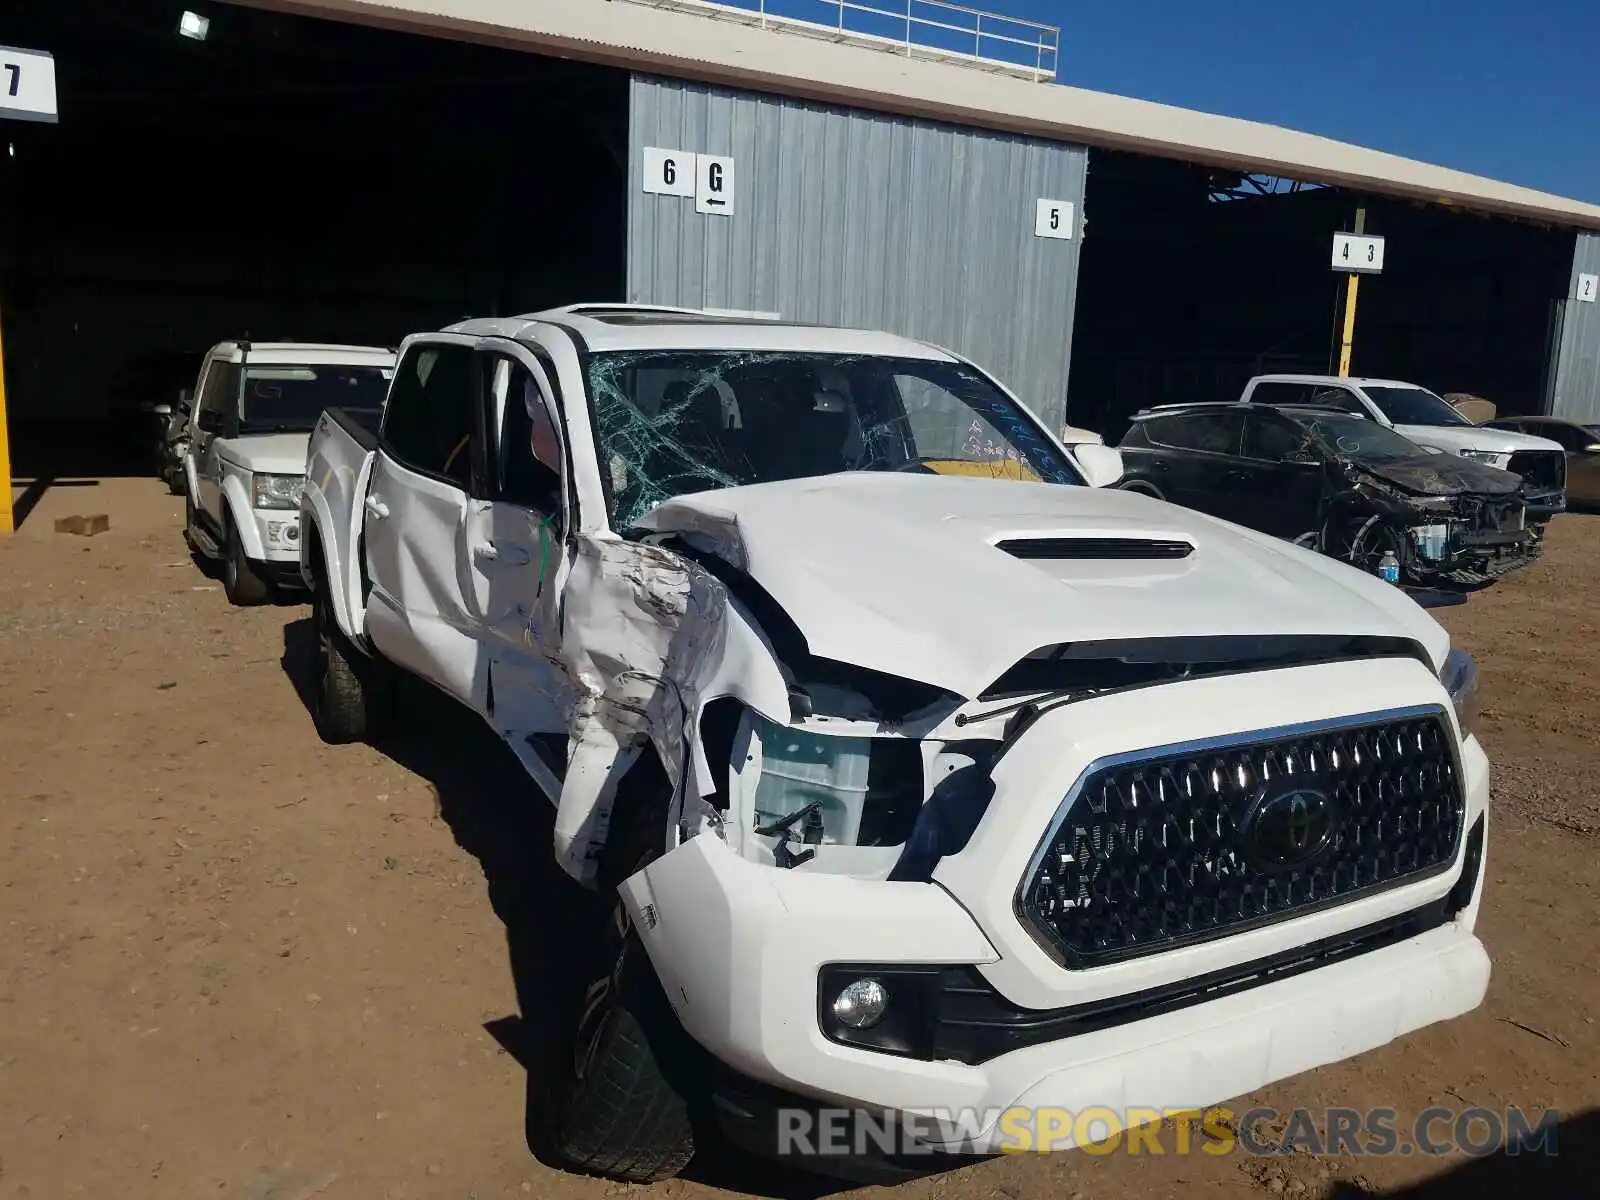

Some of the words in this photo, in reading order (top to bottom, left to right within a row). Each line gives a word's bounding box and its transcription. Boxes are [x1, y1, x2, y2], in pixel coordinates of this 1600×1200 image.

[4, 63, 21, 97] 7
[663, 158, 676, 186] 6
[709, 162, 723, 193] G
[1050, 208, 1059, 230] 5
[1342, 242, 1350, 261] 4
[1367, 244, 1375, 263] 3
[1584, 279, 1591, 296] 2
